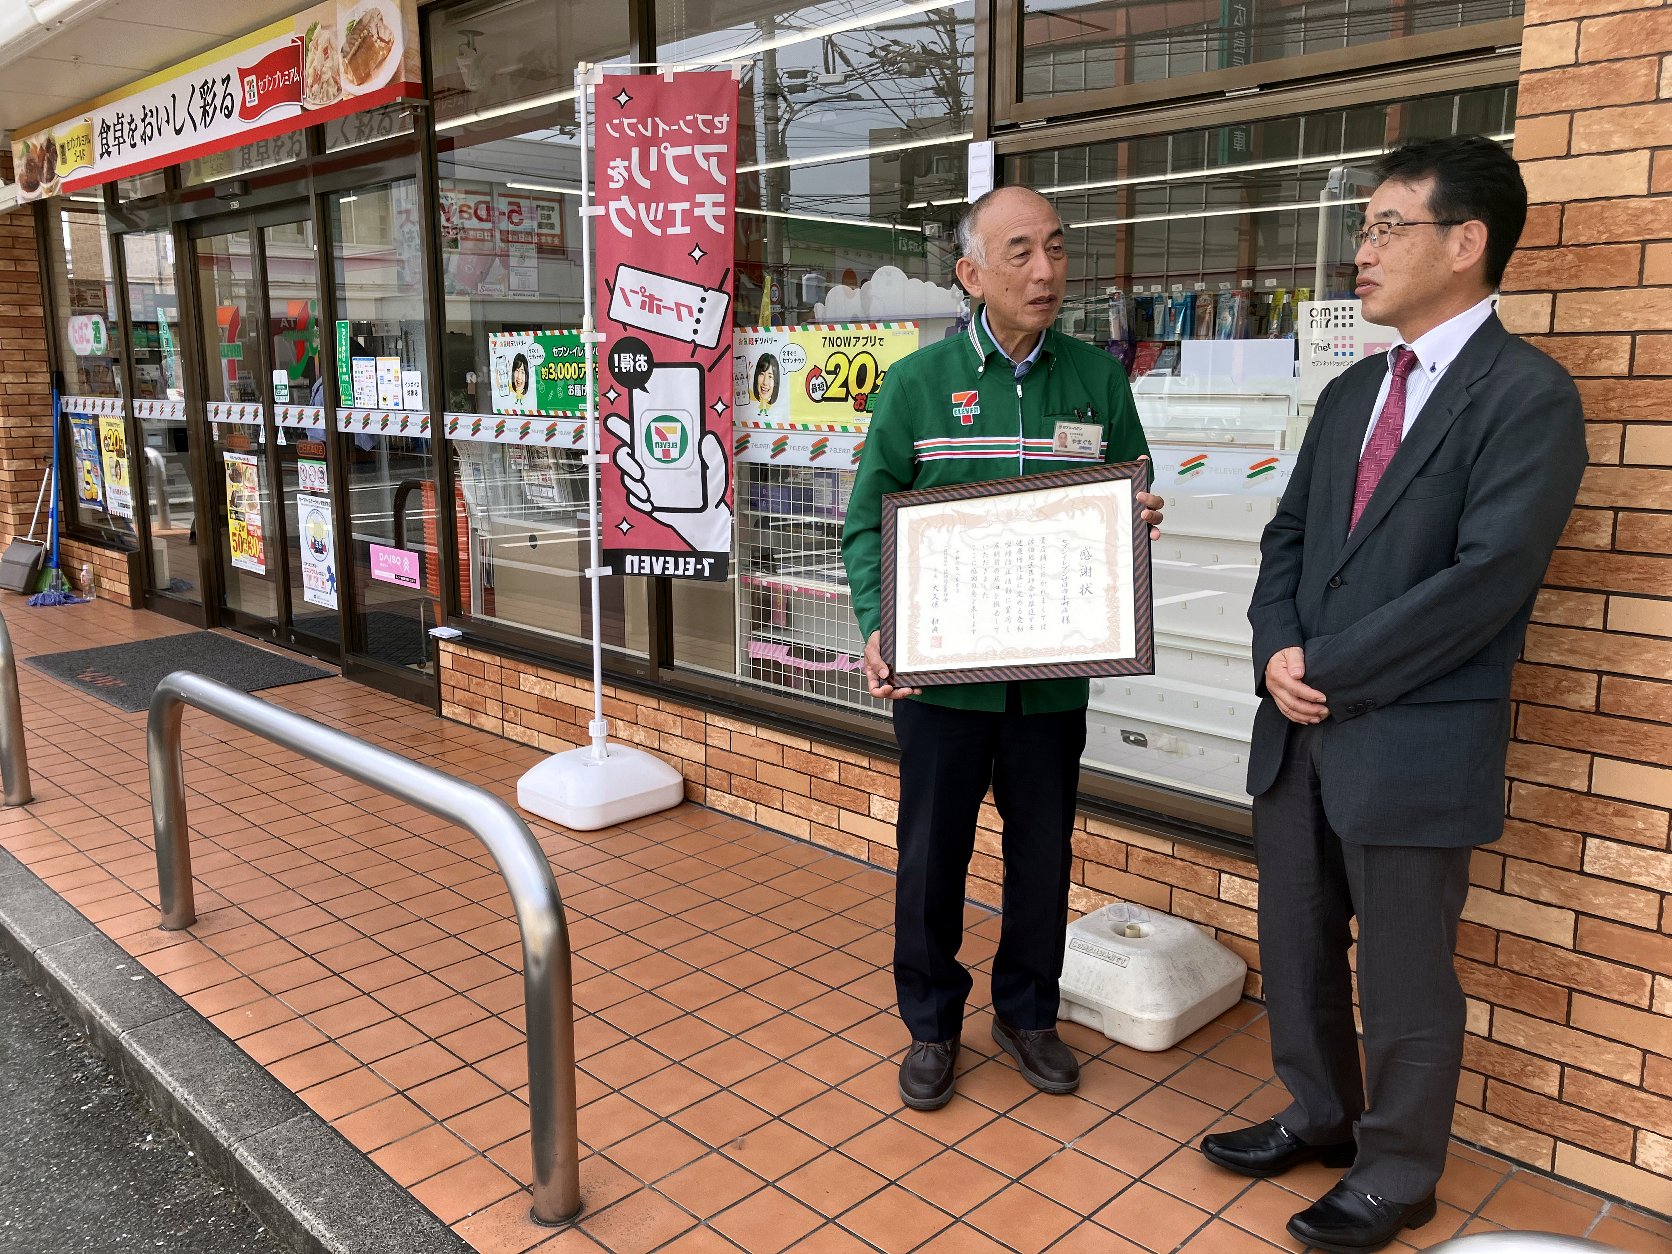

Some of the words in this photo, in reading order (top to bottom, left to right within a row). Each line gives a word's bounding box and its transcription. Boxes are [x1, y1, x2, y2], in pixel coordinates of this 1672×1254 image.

[257, 67, 300, 94] セブンプレミアム
[98, 73, 236, 160] 食卓をおいしく彩る
[821, 336, 885, 348] 7NOWアプリで
[1079, 546, 1094, 596] 感謝状
